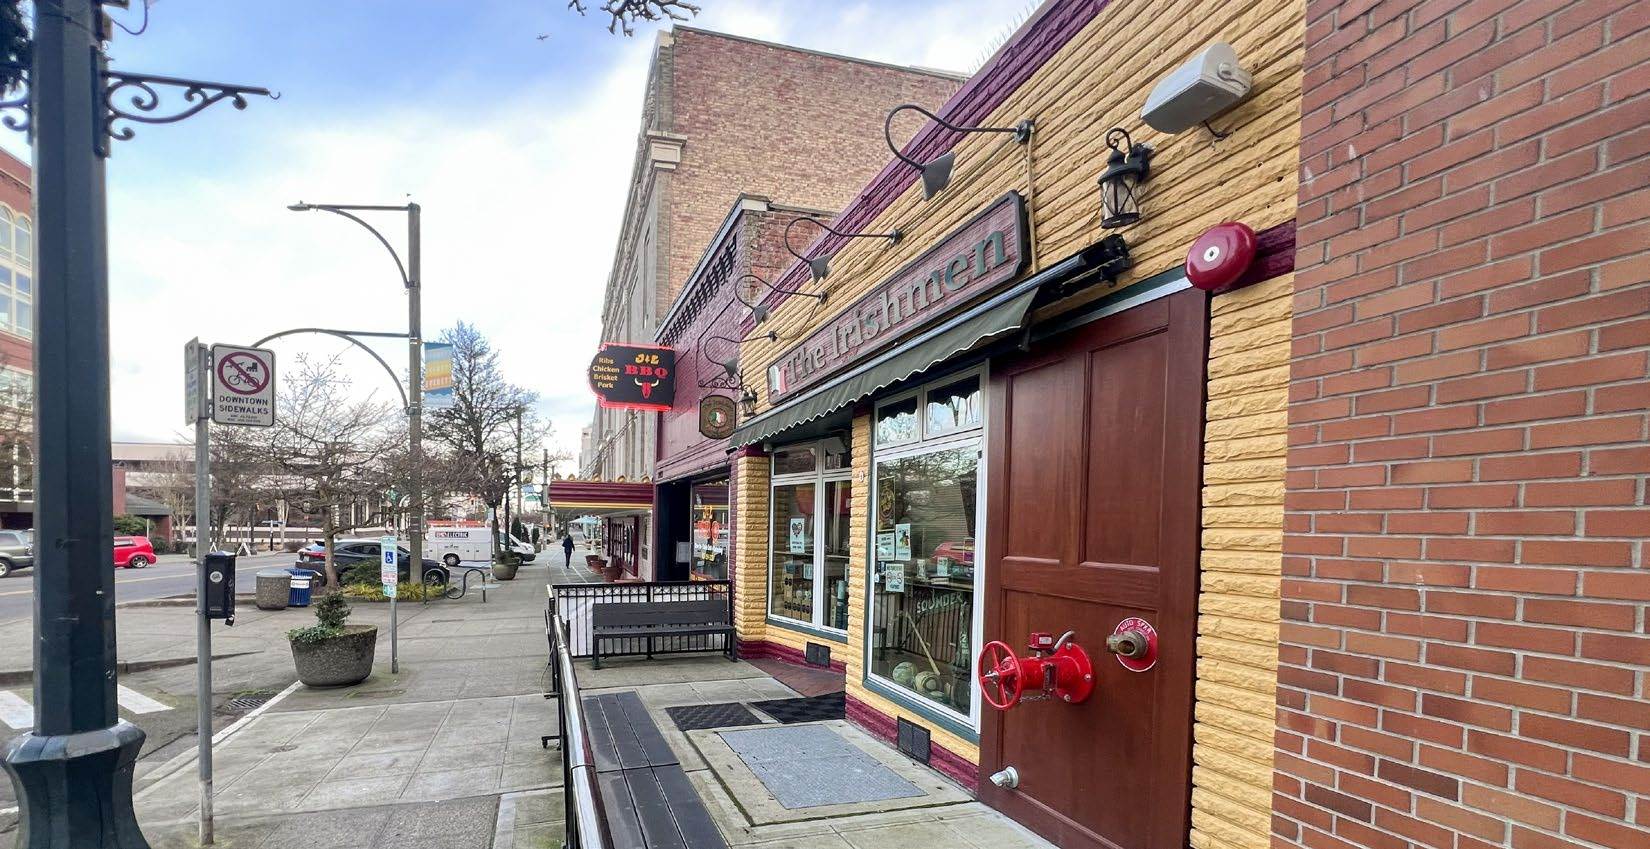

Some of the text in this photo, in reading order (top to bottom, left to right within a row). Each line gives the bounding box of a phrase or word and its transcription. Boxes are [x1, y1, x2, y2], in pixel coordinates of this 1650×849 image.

[786, 230, 1009, 385] The Irishmen
[598, 357, 614, 365] Ribs
[592, 365, 620, 373] Chicken
[624, 364, 668, 379] BBQ
[593, 374, 618, 382] Brisket
[219, 395, 269, 406] DOWNTOWN
[219, 404, 269, 415] SIDEWALKS
[1119, 620, 1135, 632] AUTO
